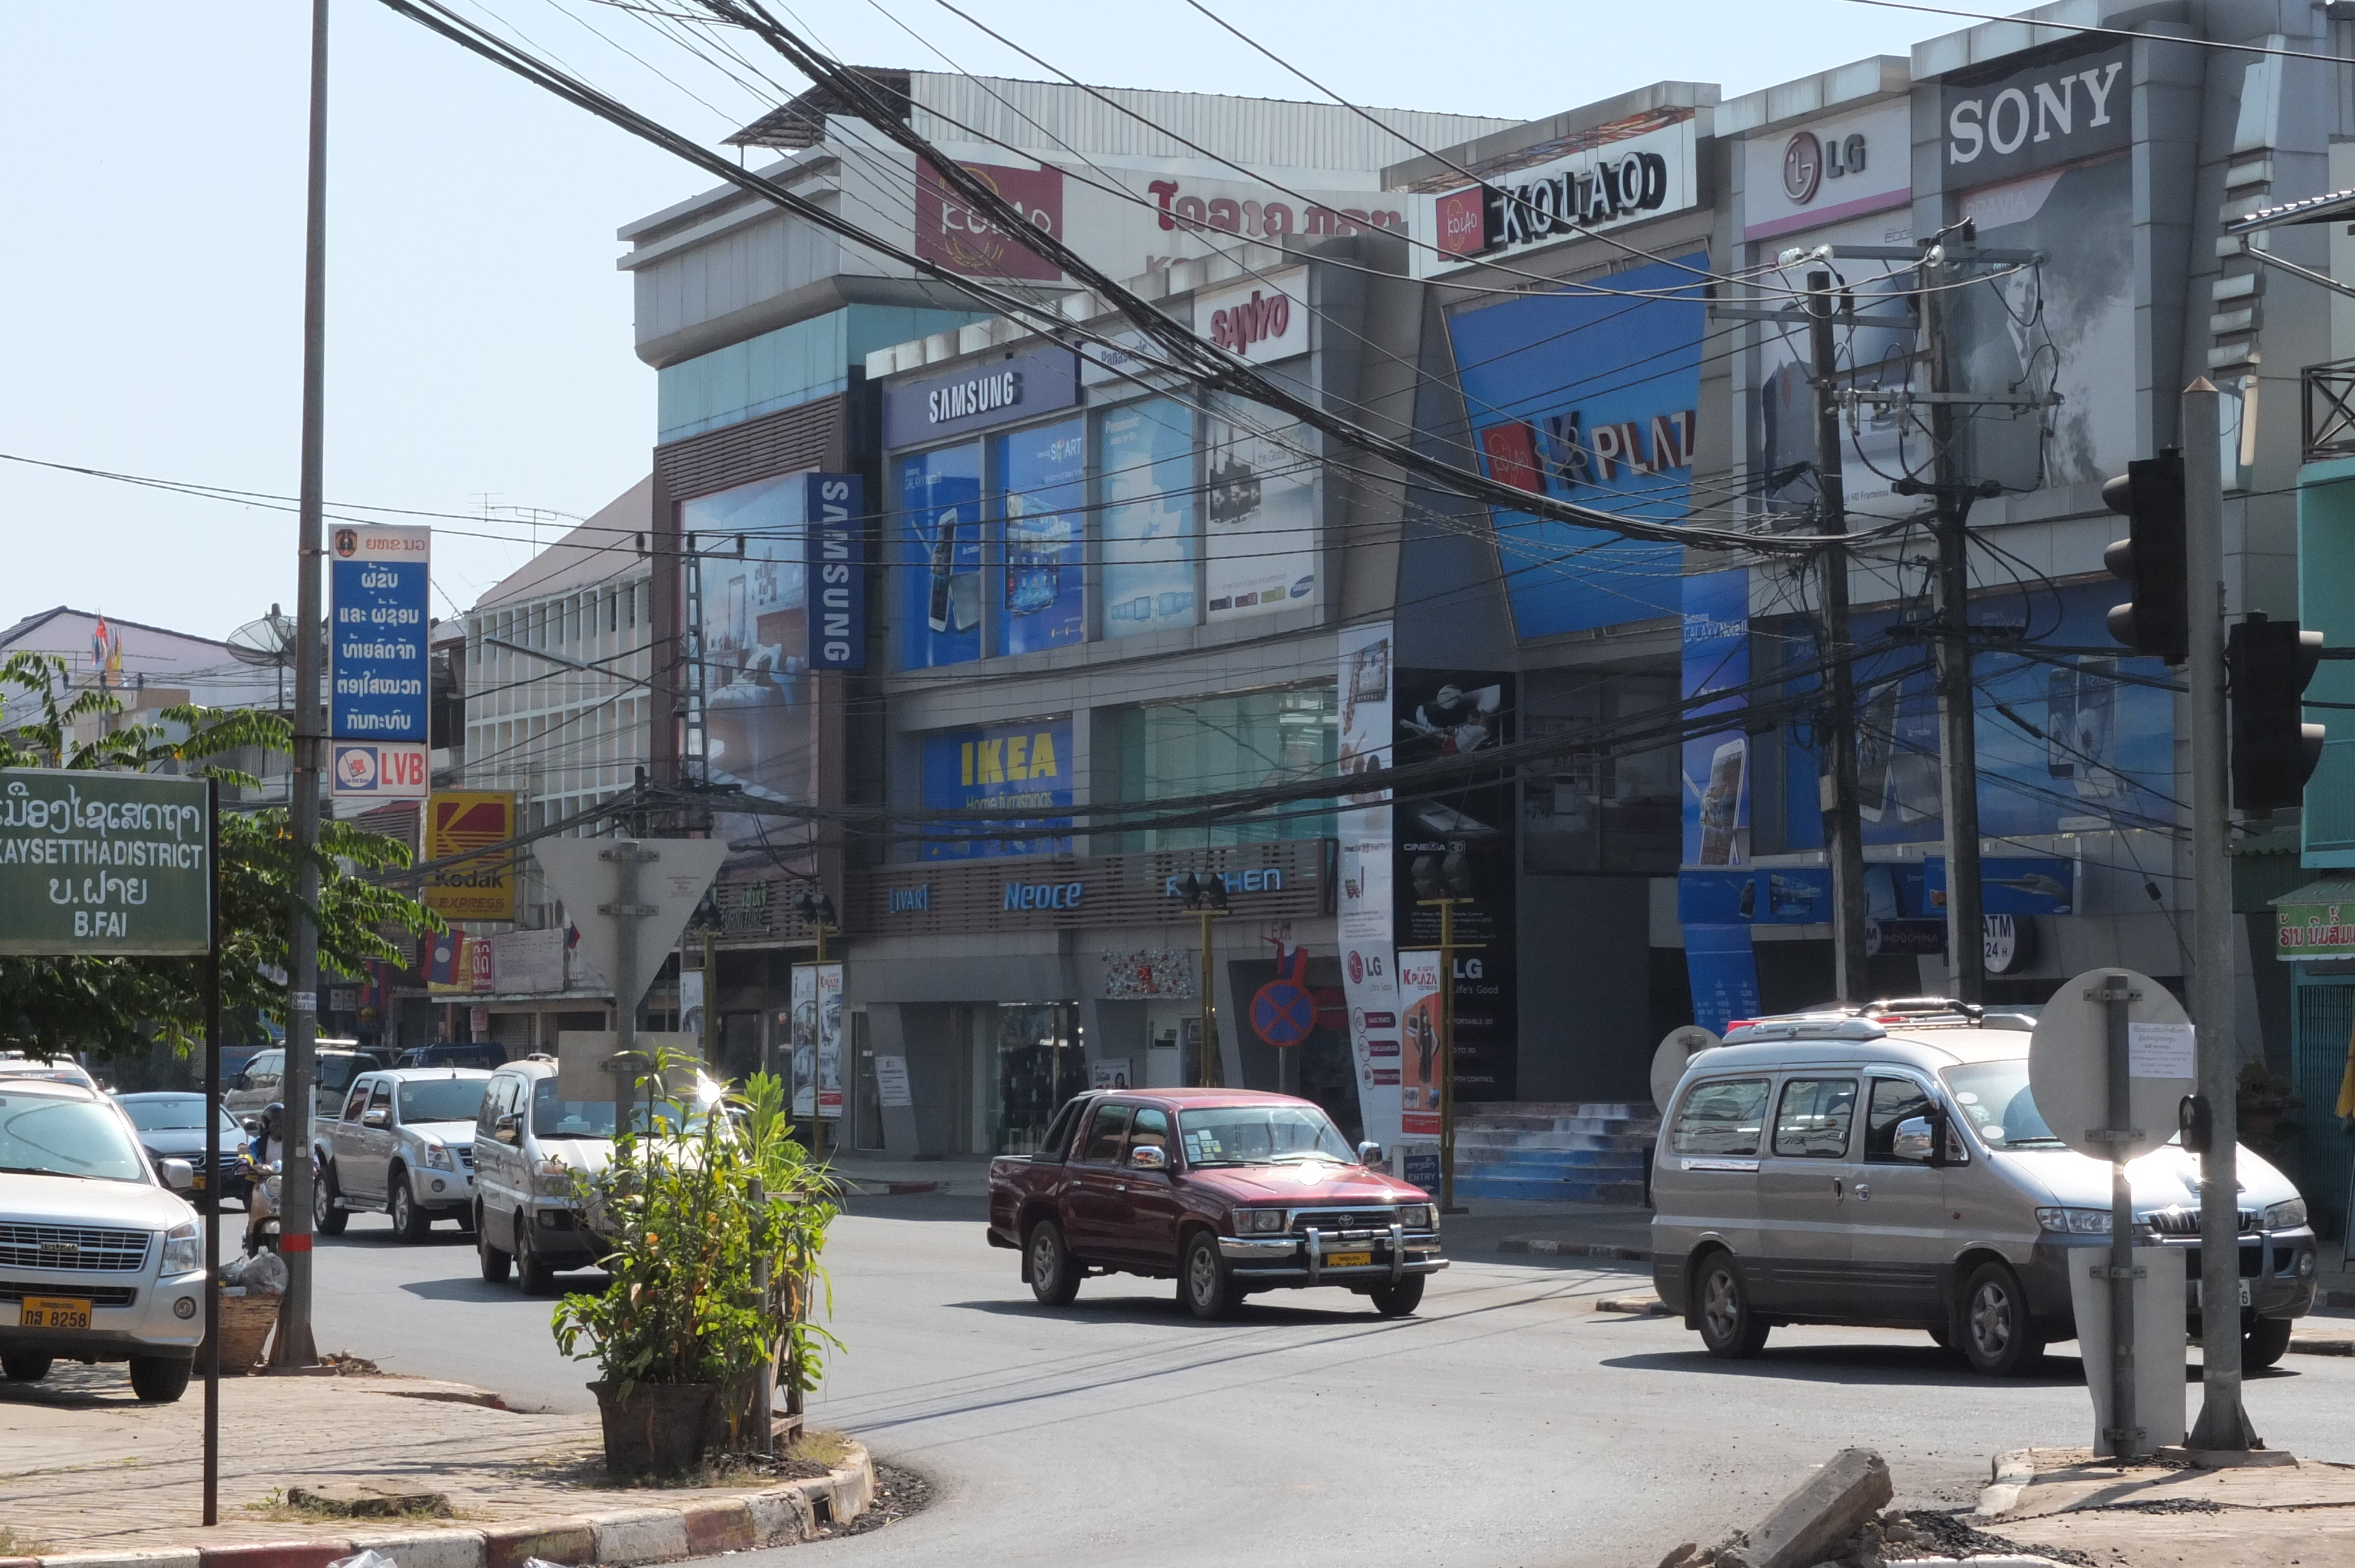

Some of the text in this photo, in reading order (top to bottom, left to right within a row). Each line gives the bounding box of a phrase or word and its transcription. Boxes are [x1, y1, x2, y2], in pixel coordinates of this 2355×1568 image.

[1949, 62, 2122, 164] SONY
[1826, 134, 1866, 178] LG
[1503, 151, 1646, 242] KOLAO
[1965, 191, 2026, 222] BRAVIA
[1448, 211, 1477, 238] KOLAO
[1210, 290, 1288, 355] SANYO
[929, 372, 1015, 423] SAMSUNG
[822, 481, 850, 662] SAMSUNG
[382, 753, 423, 785] LVB
[961, 732, 1057, 786] IKEA
[0, 839, 112, 866] AYSETTHA
[1404, 840, 1465, 853] CINEMA 3D
[436, 869, 503, 888] Kodak
[439, 897, 504, 908] EXPRESS
[74, 911, 127, 937] B.FAI
[1986, 942, 1998, 958] 24
[1366, 956, 1382, 976] LG
[1452, 958, 1482, 978] LG
[1475, 985, 1498, 994] Good
[1408, 1172, 1435, 1182] ENTRY
[51, 1311, 87, 1327] 8258
